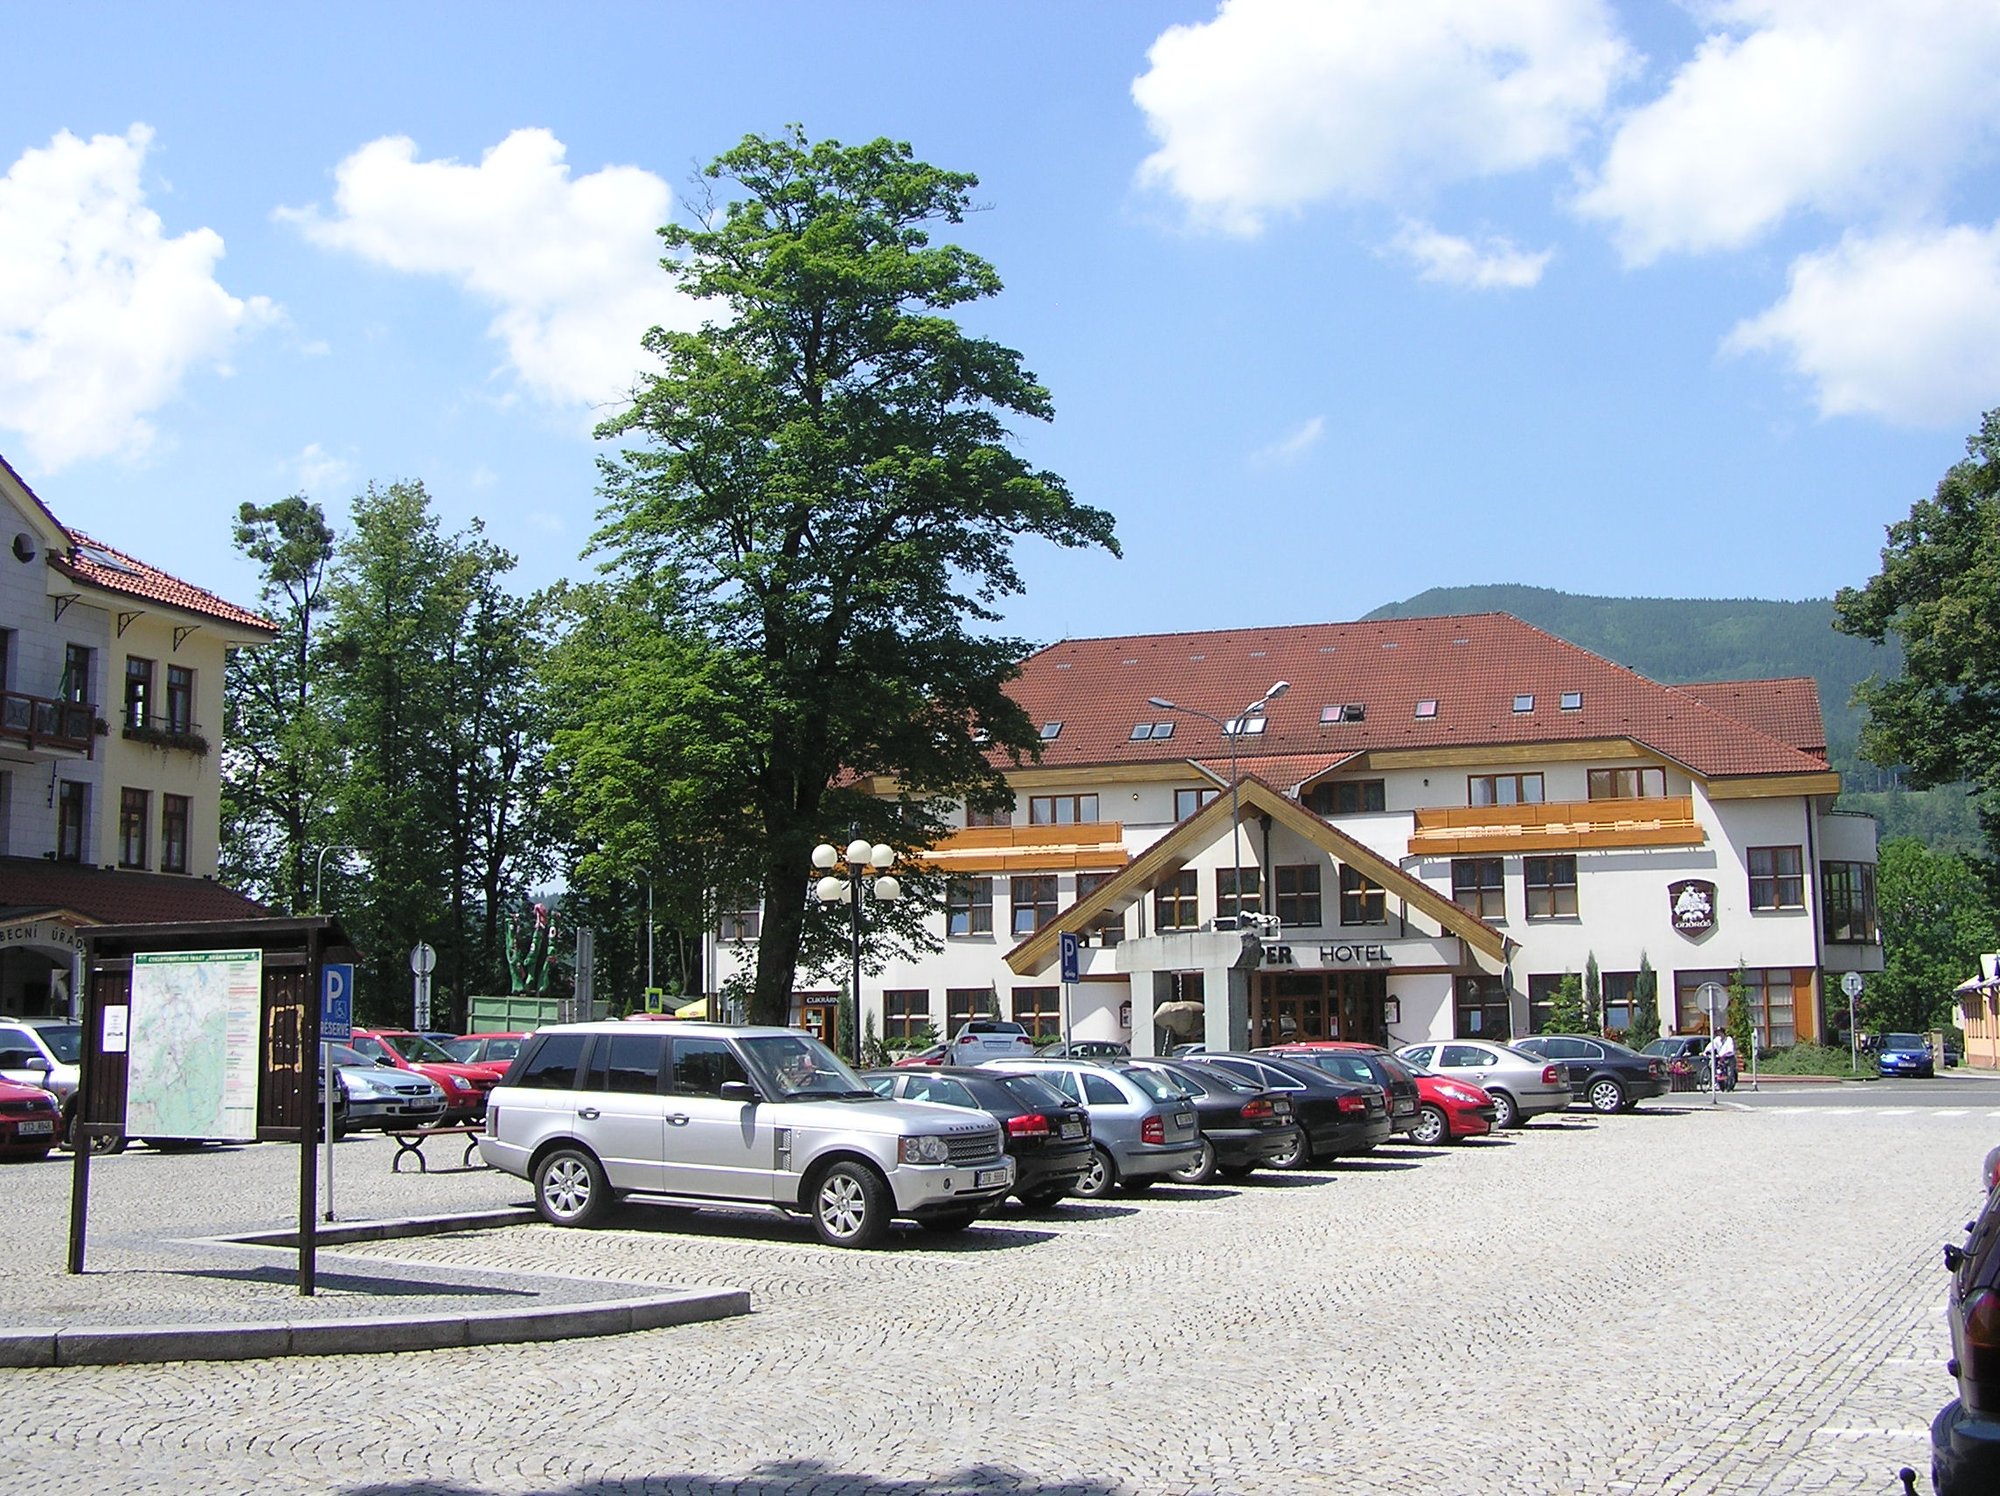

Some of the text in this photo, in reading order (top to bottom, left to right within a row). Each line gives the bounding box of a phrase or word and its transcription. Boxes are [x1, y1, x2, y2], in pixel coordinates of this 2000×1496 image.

[52, 926, 83, 949] ÚŘAD
[1064, 938, 1075, 967] P
[1319, 944, 1393, 962] HOTEL
[326, 970, 344, 1014] P
